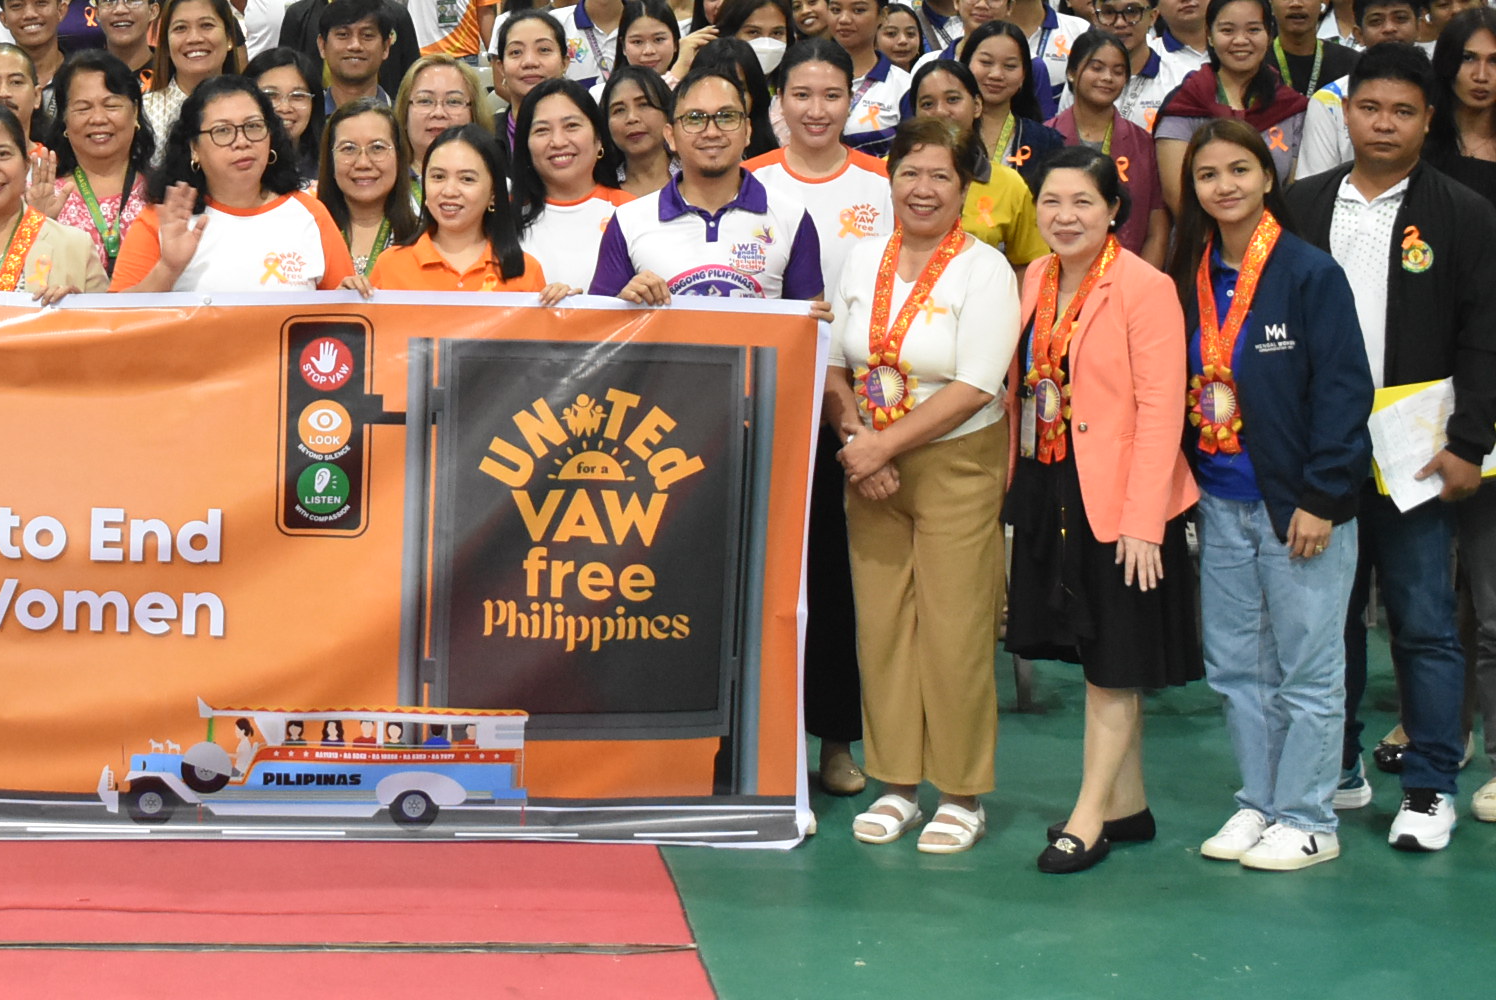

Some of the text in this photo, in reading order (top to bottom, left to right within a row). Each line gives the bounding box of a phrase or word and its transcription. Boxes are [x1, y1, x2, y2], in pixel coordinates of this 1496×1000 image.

[669, 269, 707, 295] BAGONG
[303, 363, 350, 384] STOP VAW
[309, 435, 340, 445] LOOK
[297, 443, 351, 461] BEYOND SILENCE
[576, 461, 609, 474] for a
[305, 496, 342, 505] LISTEN
[309, 504, 351, 523] COMPASSION
[511, 488, 669, 547] VAW
[89, 507, 223, 564] End
[523, 546, 656, 602] free
[482, 599, 691, 653] Philippines
[262, 772, 362, 786] PILIPINAS
